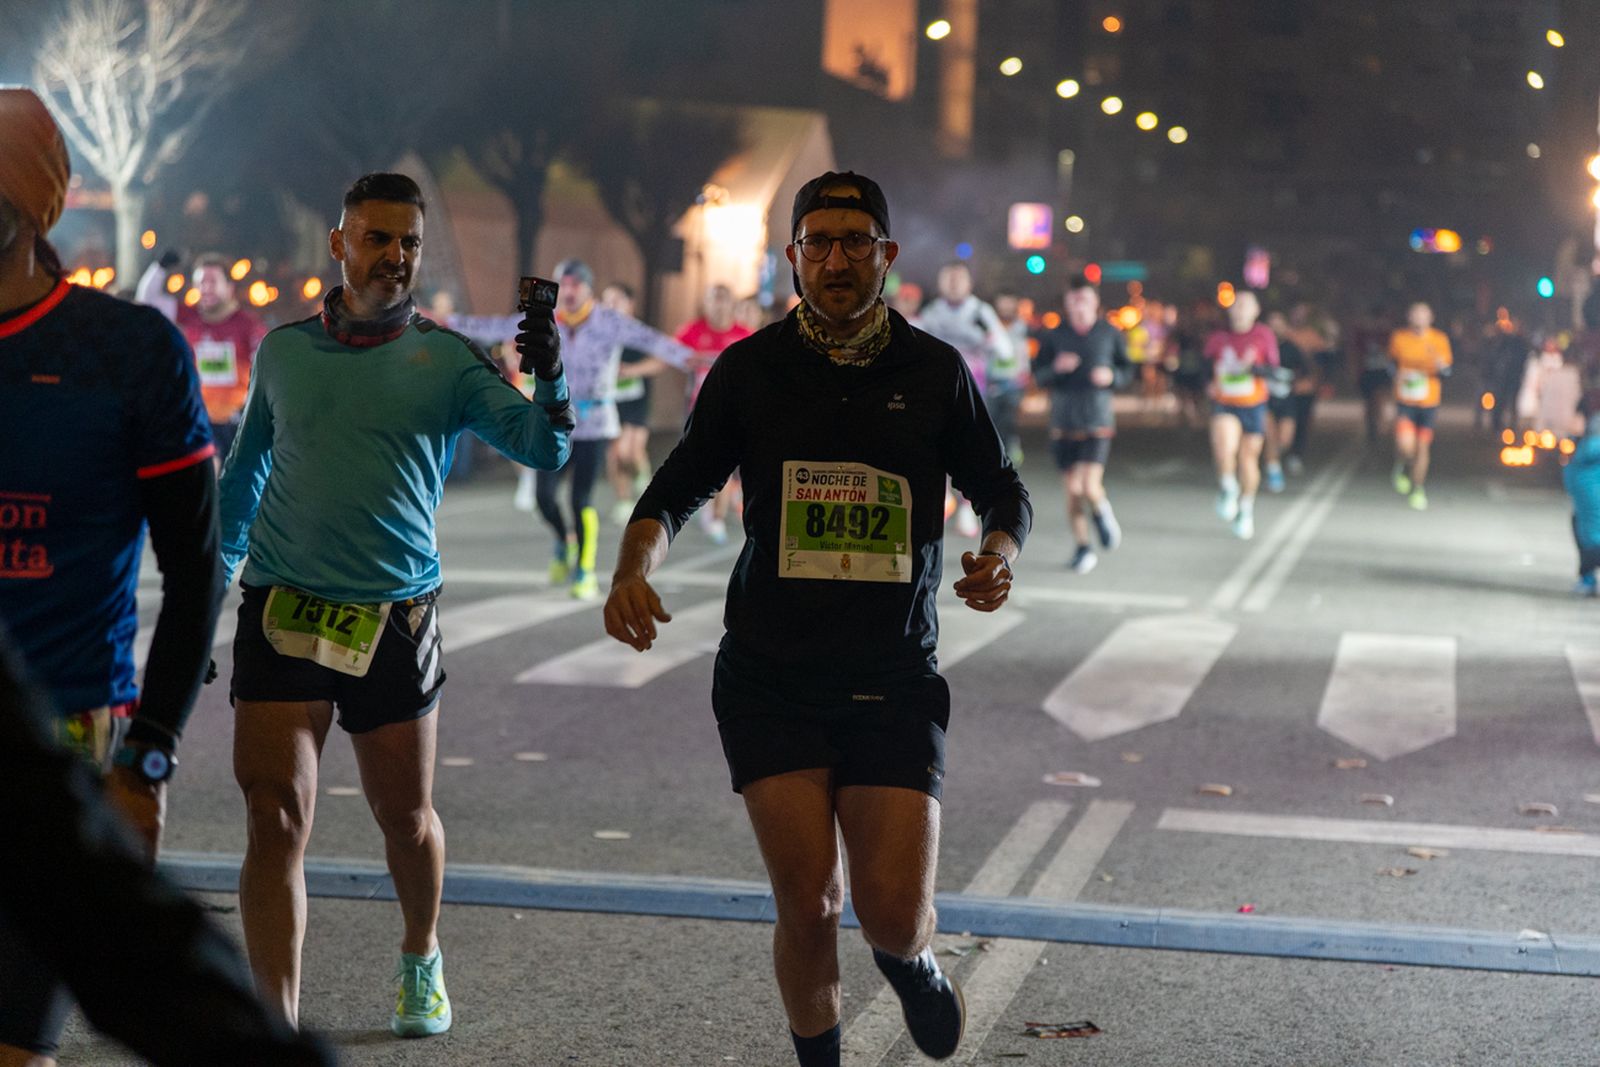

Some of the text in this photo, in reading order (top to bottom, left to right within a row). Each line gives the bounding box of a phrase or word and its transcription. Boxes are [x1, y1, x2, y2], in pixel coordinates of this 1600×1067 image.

[812, 475, 849, 486] NOCHE
[852, 476, 867, 487] DE
[796, 488, 822, 501] SAN
[824, 488, 867, 502] ANTÓN
[806, 504, 890, 541] 8492
[292, 594, 359, 635] 7512
